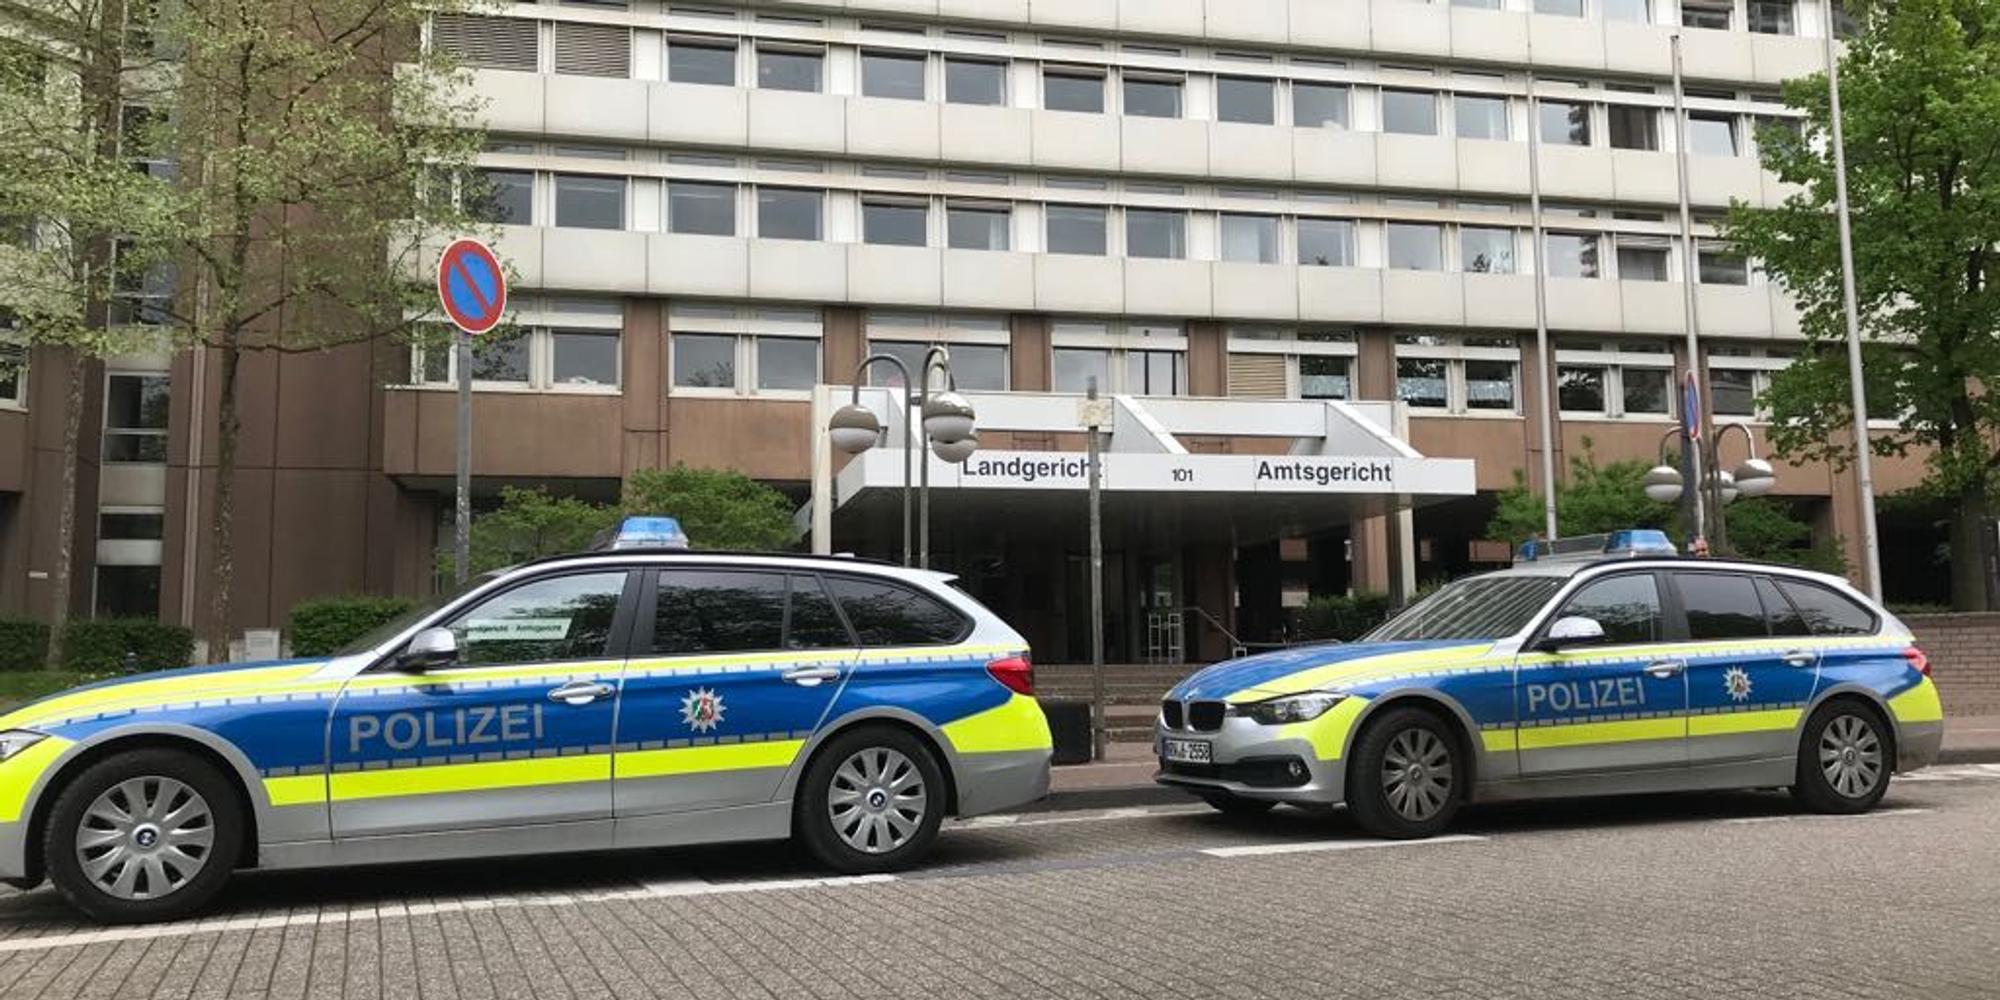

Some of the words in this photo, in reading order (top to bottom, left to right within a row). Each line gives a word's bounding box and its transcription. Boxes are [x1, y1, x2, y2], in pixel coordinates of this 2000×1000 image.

[963, 457, 1102, 481] Landgerich
[1172, 468, 1193, 482] 101
[1258, 461, 1392, 485] Amtsgericht
[1527, 676, 1645, 712] POLIZEI
[350, 703, 544, 752] POLIZEI
